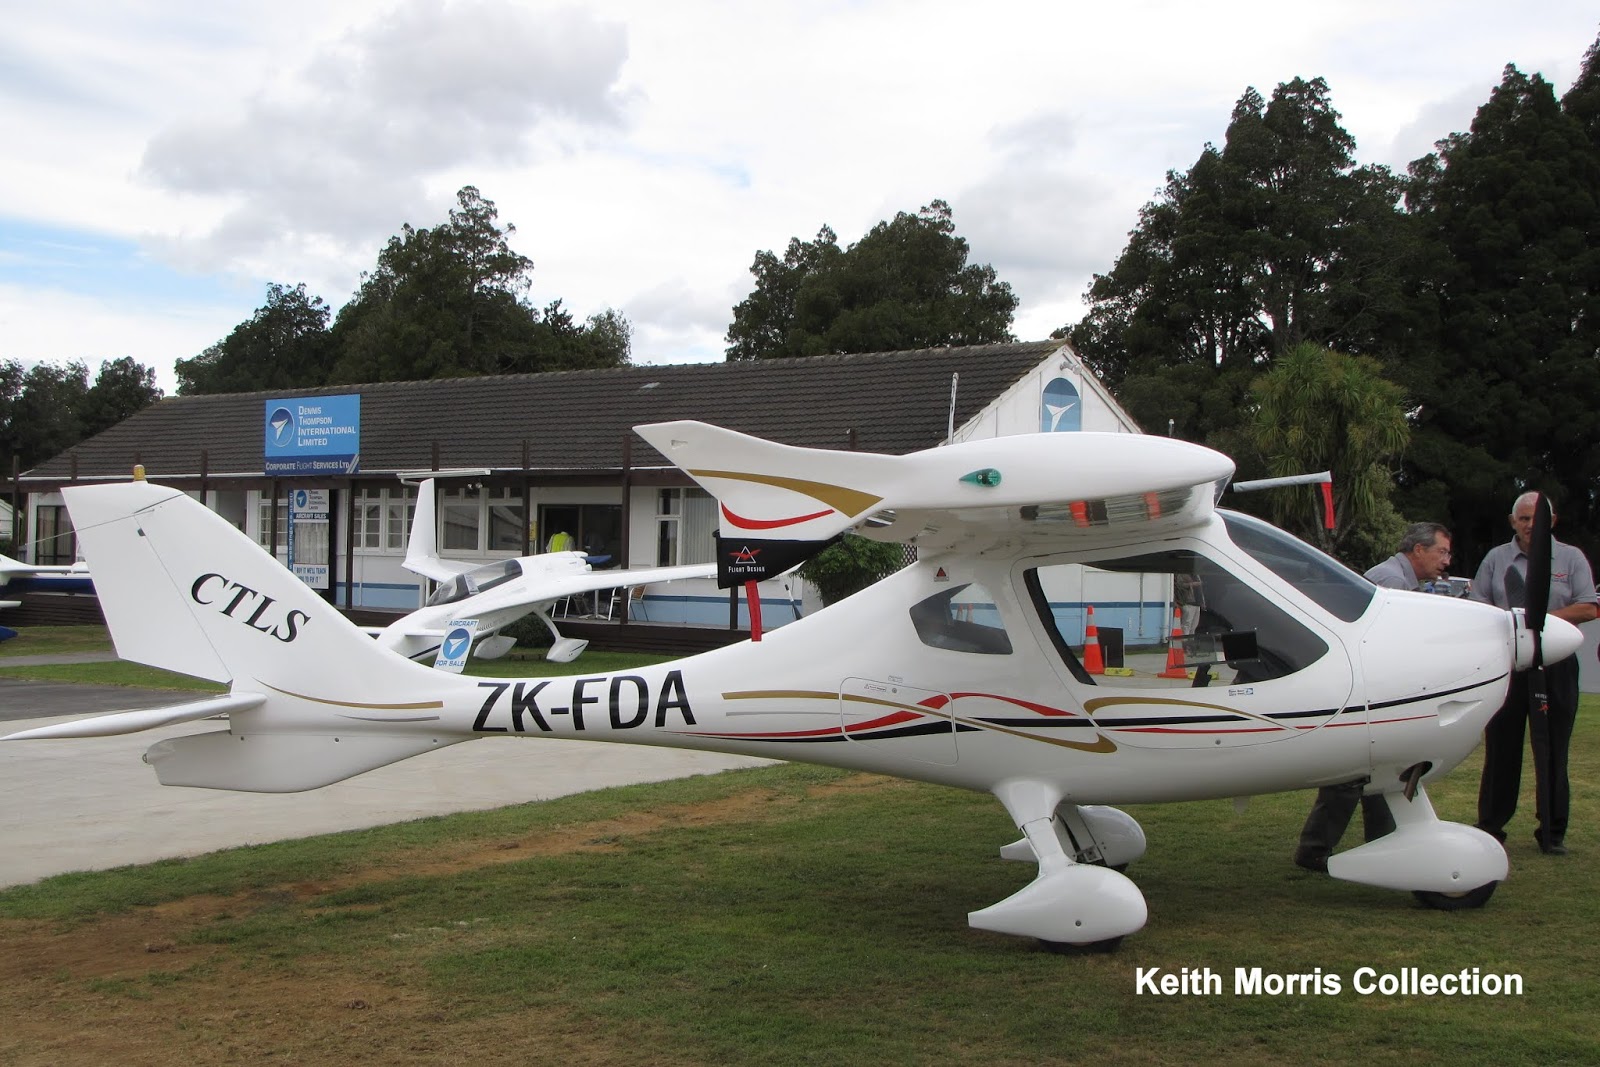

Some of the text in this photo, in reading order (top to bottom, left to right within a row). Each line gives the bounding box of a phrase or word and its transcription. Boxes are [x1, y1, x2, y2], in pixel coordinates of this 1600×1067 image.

[298, 426, 356, 436] INTERNATIONAL
[298, 437, 328, 447] LIMITED
[190, 573, 312, 643] CTLS
[472, 669, 697, 732] ZK-FDA
